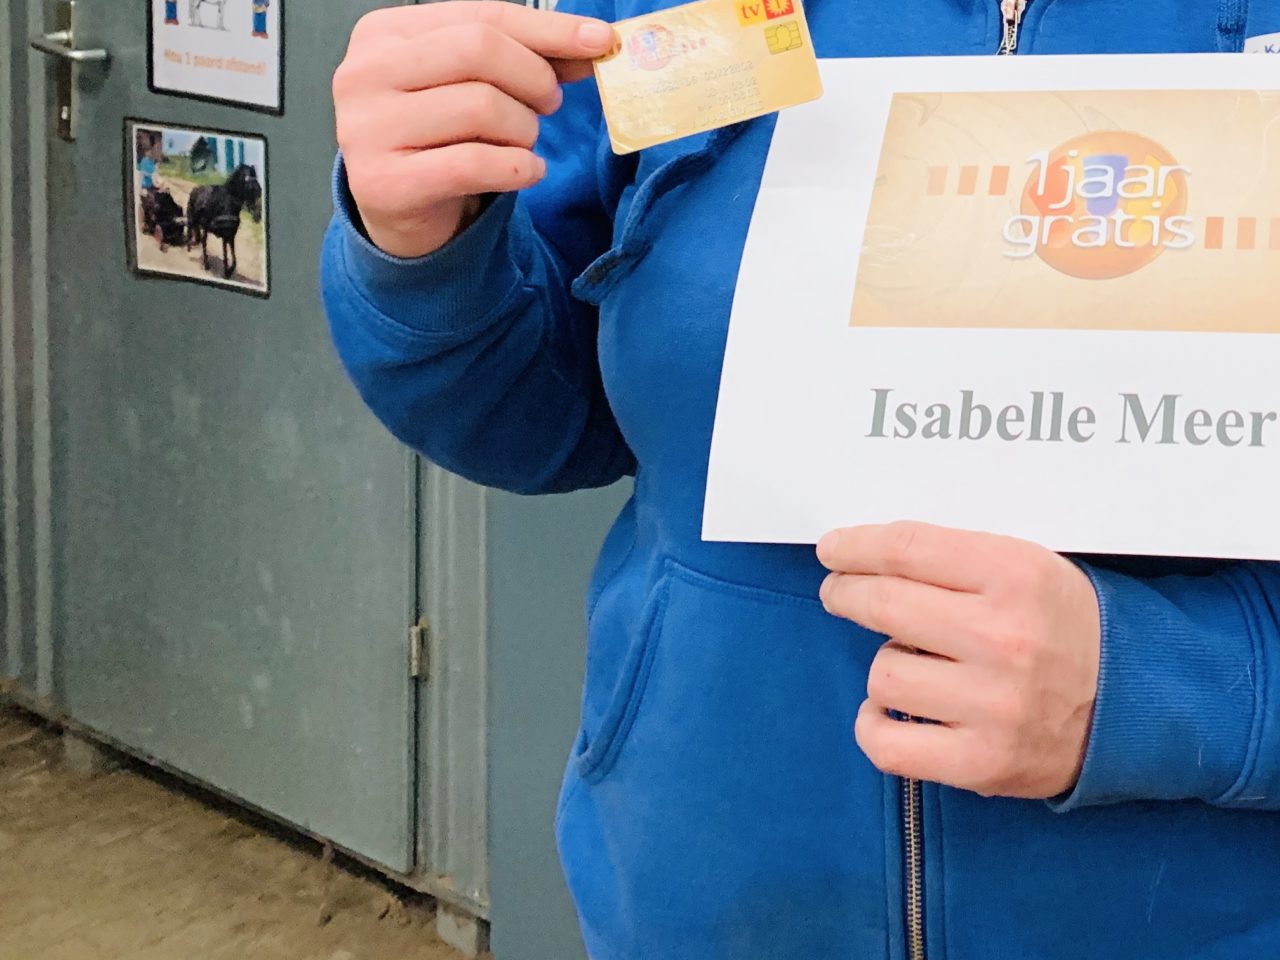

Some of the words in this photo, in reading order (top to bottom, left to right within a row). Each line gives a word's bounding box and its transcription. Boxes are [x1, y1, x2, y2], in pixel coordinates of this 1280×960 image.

[1026, 150, 1049, 196] 1
[1048, 149, 1192, 209] jaar
[1001, 201, 1196, 258] gratis
[864, 388, 1097, 442] Isabelle
